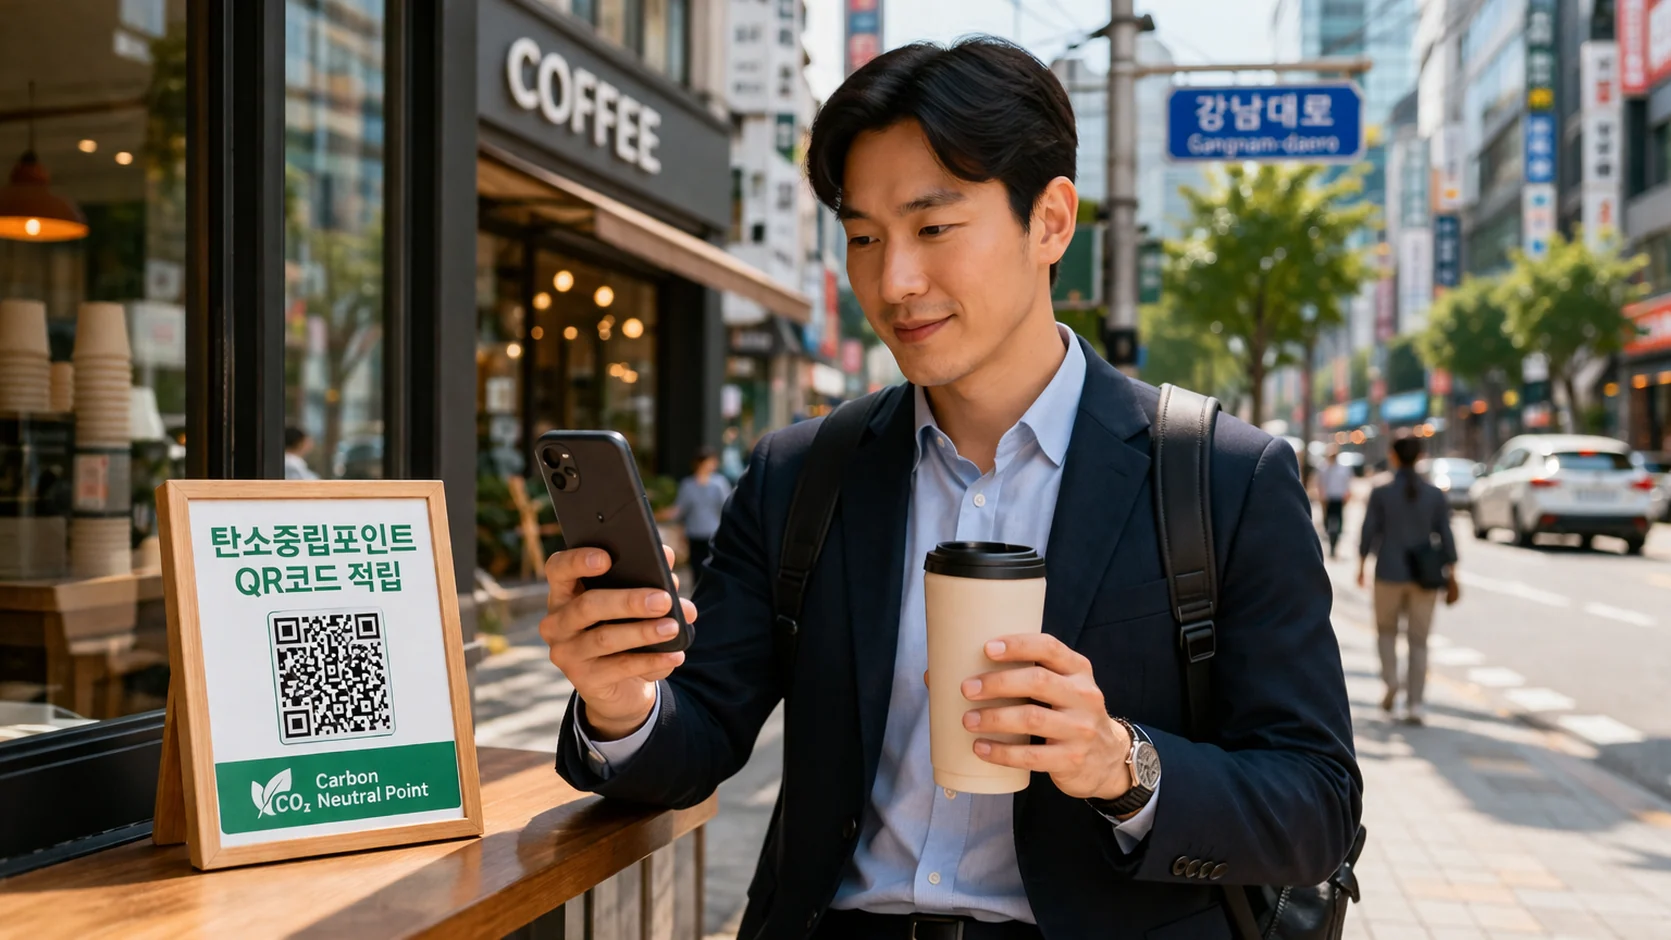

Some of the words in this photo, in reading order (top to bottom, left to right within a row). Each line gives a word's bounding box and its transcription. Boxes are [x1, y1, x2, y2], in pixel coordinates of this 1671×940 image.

[507, 37, 662, 175] COFFEE
[1195, 92, 1335, 132] 강남대로
[210, 523, 417, 558] 탄소중립포인트
[235, 565, 342, 598] QR코드
[347, 561, 402, 592] 적립
[316, 770, 379, 789] Carbon
[317, 786, 381, 809] Neutral
[385, 782, 429, 801] Point
